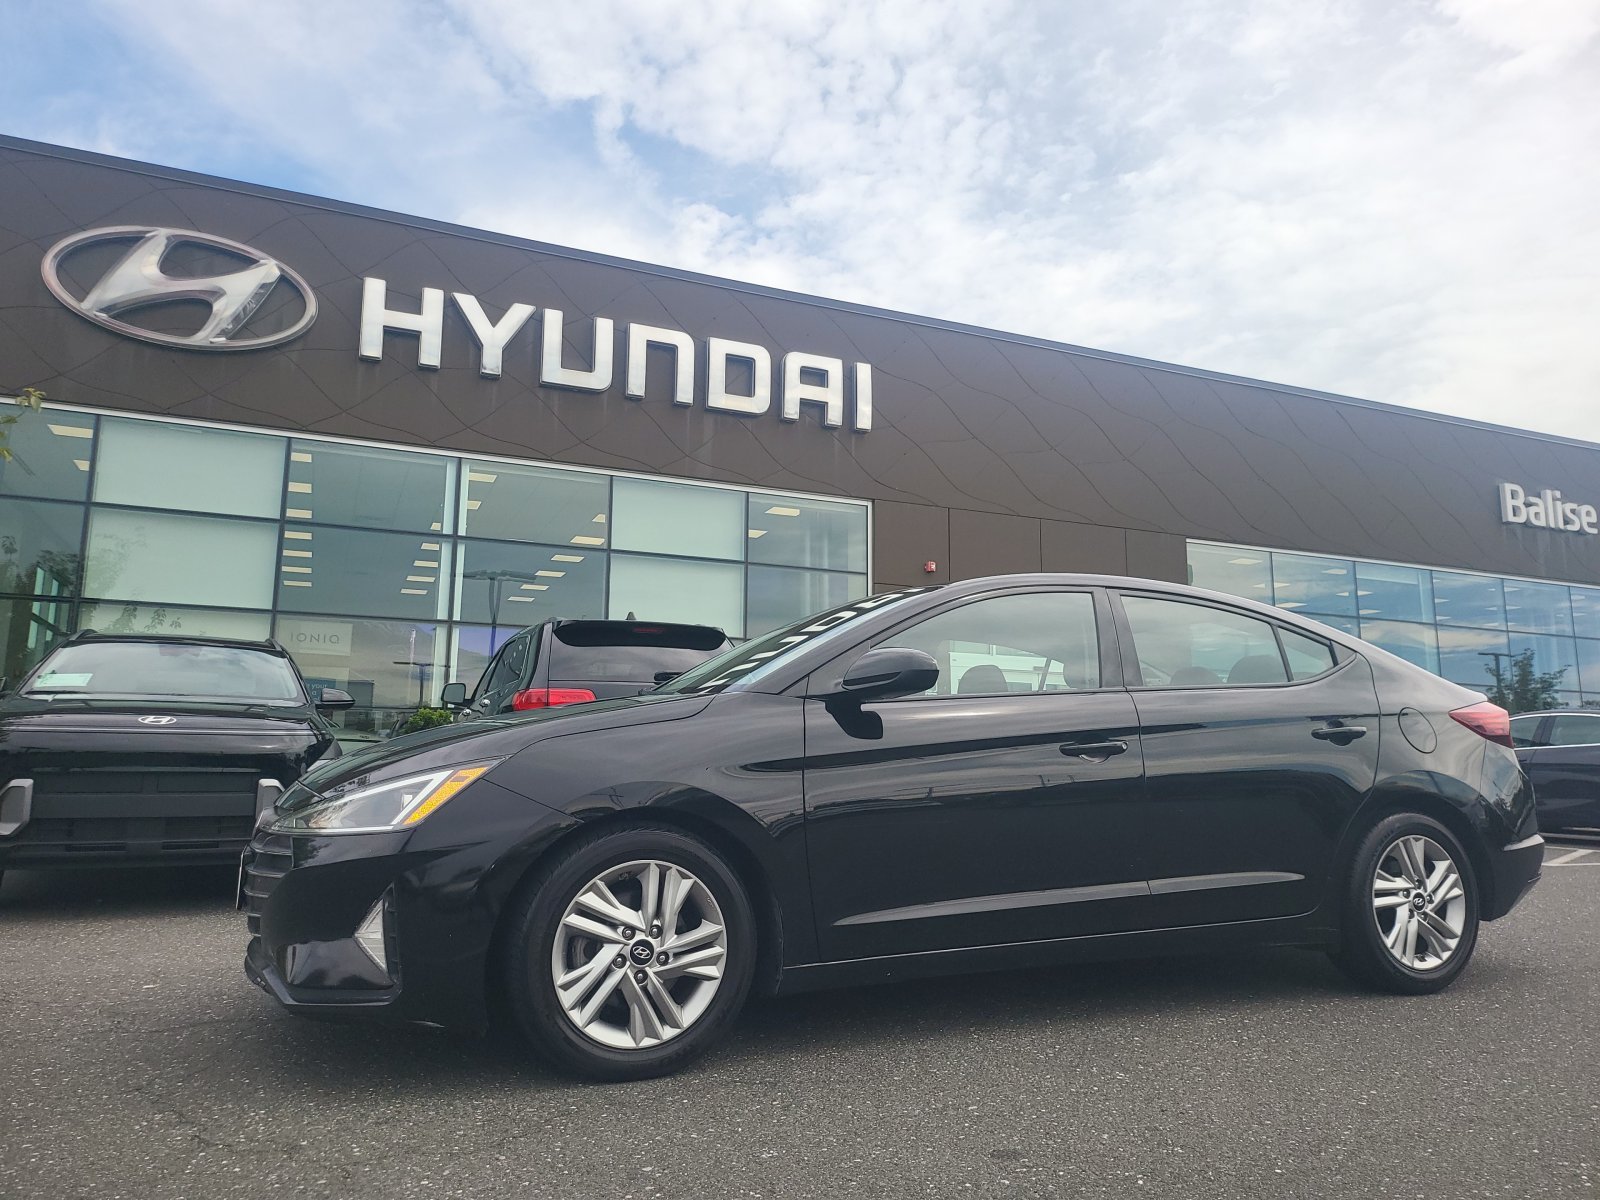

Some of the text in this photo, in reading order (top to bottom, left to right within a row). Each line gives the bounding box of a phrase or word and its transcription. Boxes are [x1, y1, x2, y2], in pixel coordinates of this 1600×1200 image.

[359, 276, 874, 433] HYUNDAI
[1499, 482, 1598, 534] Balise
[290, 632, 340, 645] IONIQ
